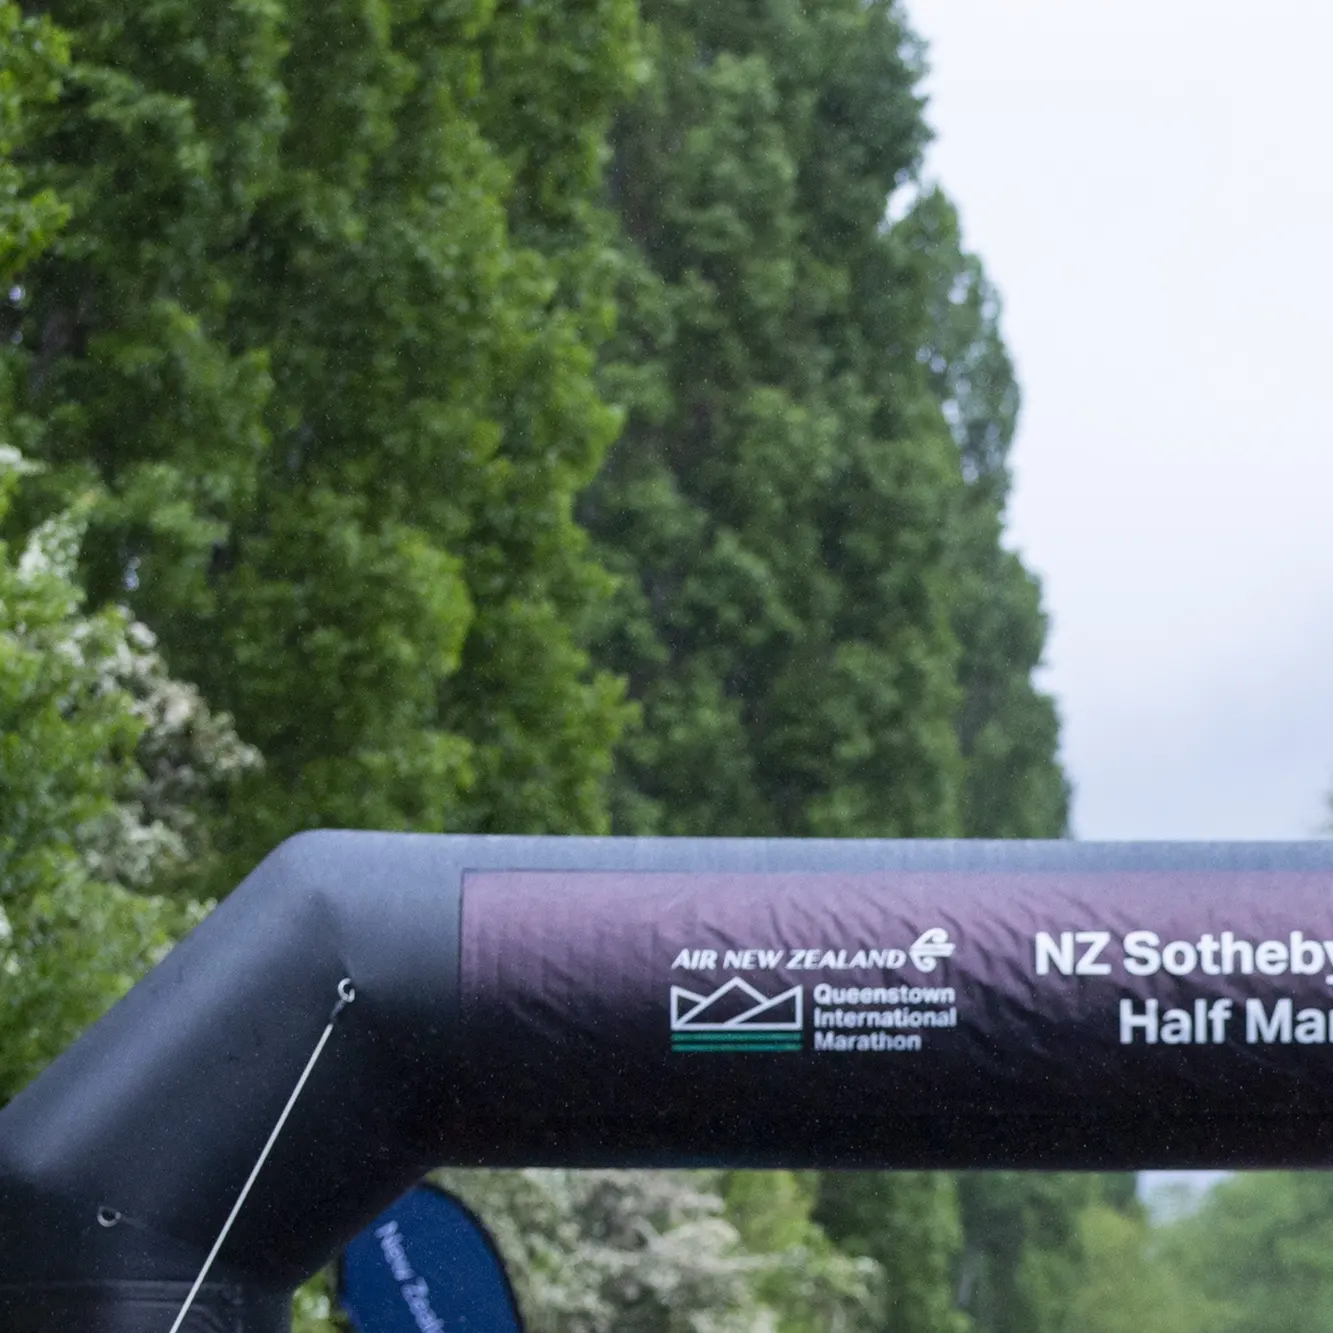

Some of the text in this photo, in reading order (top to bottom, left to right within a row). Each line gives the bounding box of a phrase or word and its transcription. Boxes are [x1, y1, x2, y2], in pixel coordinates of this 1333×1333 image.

[671, 948, 907, 970] AIR NEW ZEALAND
[1034, 931, 1112, 976] NZ
[813, 983, 957, 1005] Queenstown
[813, 1006, 958, 1028] International
[1119, 998, 1233, 1046] Half
[813, 1031, 922, 1051] Marathon
[374, 1220, 415, 1282] New
